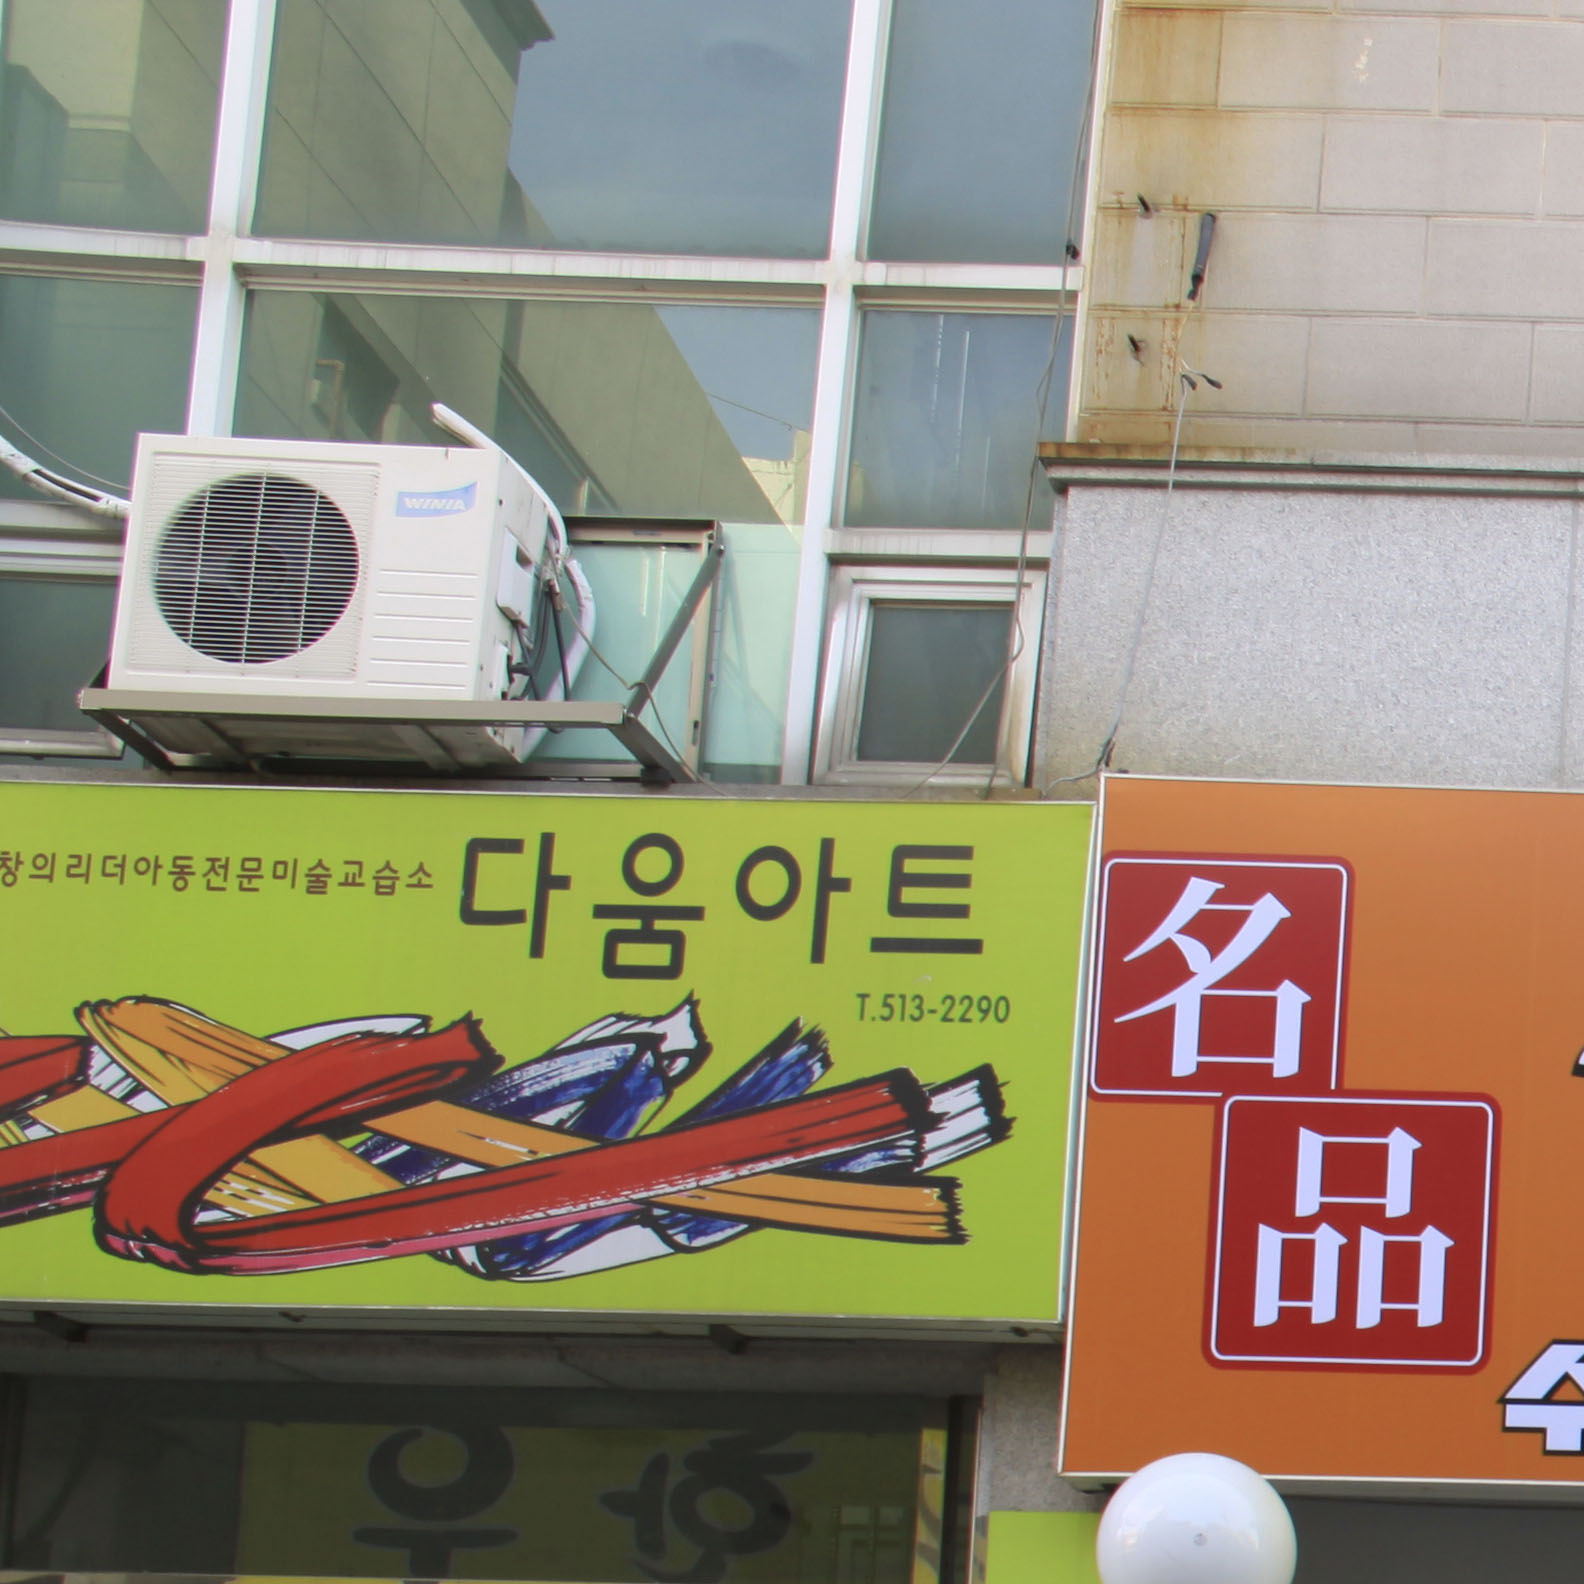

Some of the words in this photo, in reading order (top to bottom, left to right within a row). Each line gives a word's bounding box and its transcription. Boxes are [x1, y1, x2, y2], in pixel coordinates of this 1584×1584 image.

[402, 497, 467, 511] WINIA
[0, 850, 435, 897] 창의리더아동전문미술교습소
[458, 831, 985, 980] 다움아트
[855, 991, 1011, 1025] T.513-2290
